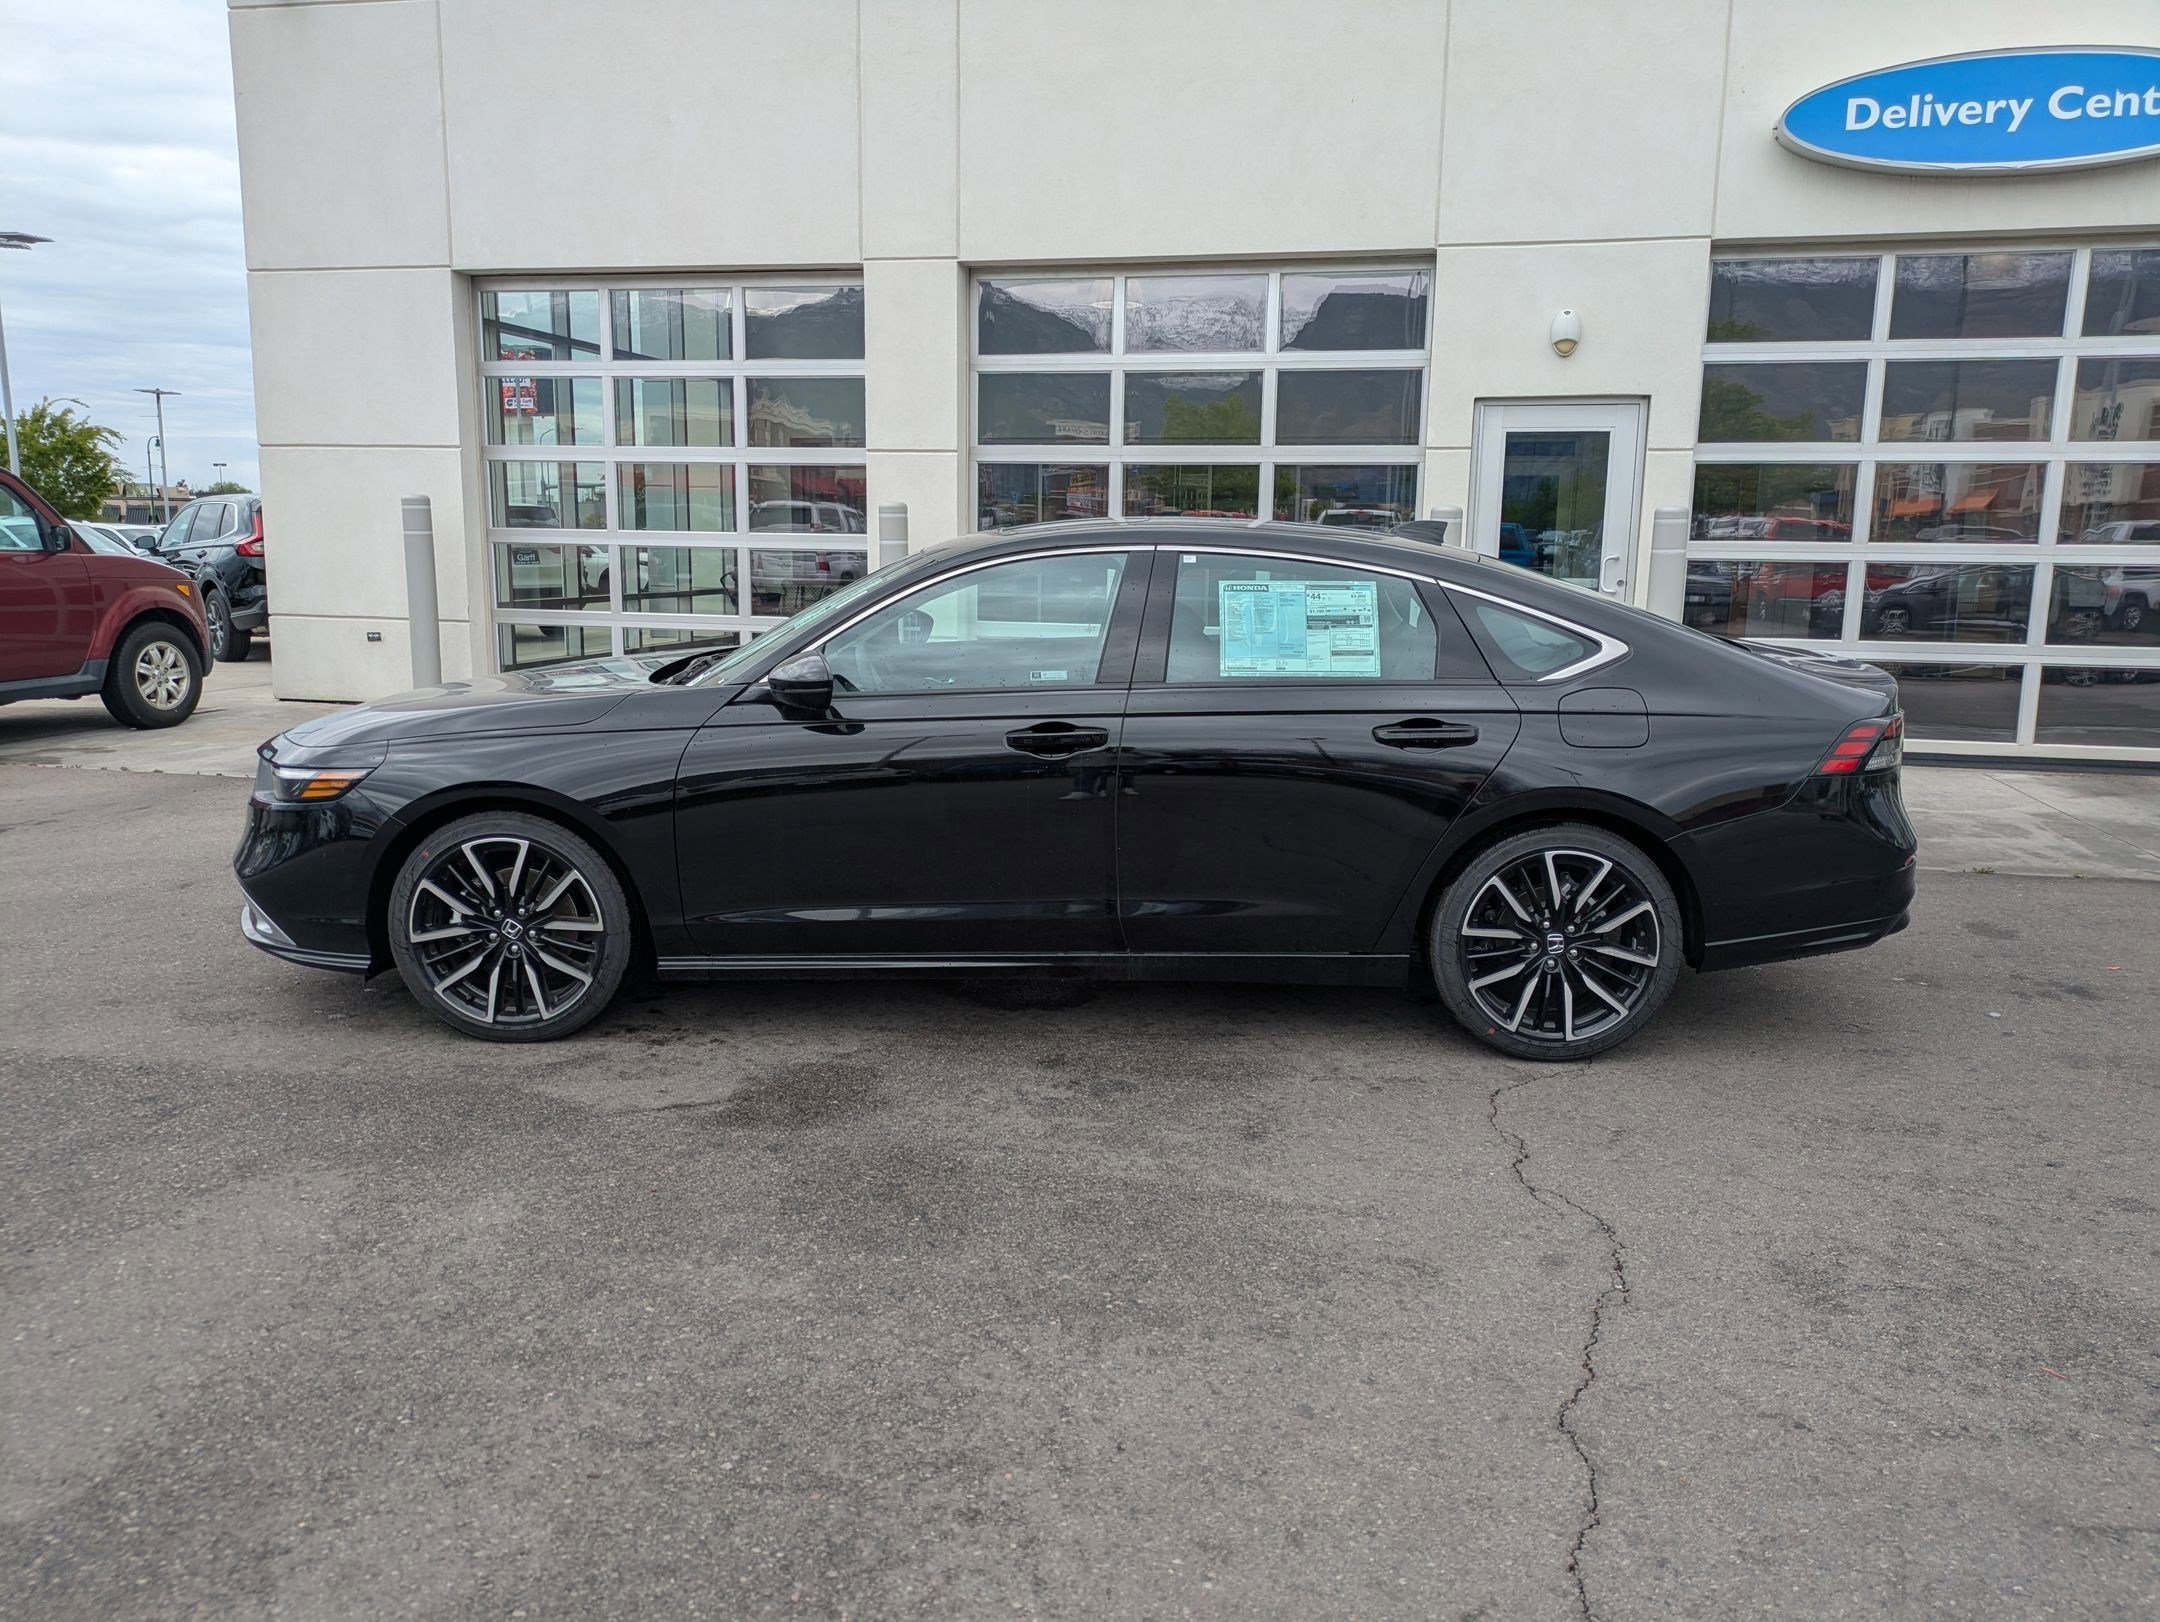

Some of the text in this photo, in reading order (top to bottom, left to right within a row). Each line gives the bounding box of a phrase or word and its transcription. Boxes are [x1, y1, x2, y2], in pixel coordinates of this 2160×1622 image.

[1845, 85, 2160, 133] Delivery Cent
[516, 553, 537, 561] Garff
[1310, 592, 1321, 600] 44
